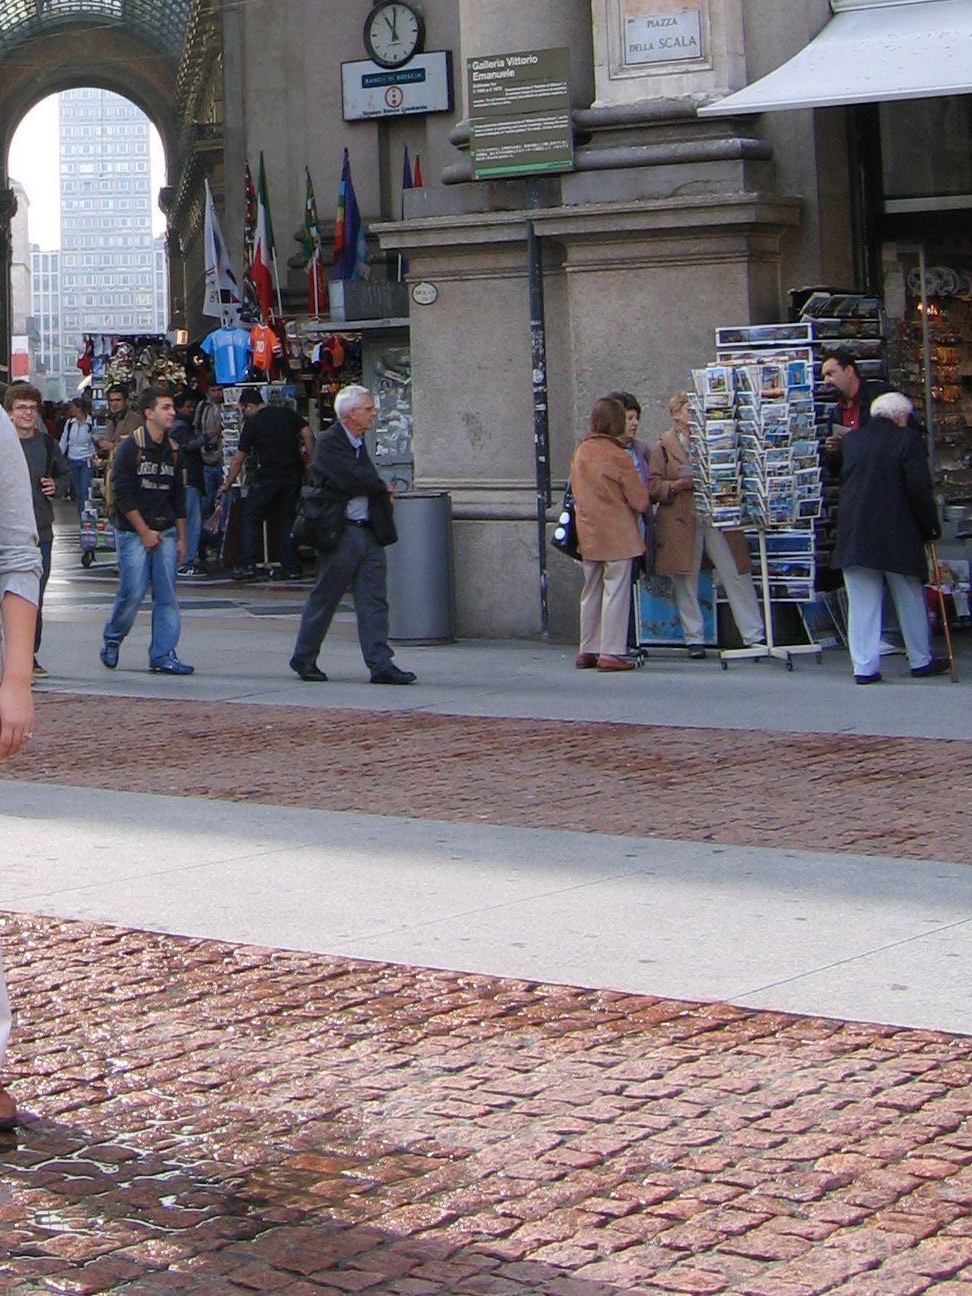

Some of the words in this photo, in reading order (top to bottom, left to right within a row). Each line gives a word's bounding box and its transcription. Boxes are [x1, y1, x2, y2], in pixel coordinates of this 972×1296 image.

[646, 17, 678, 28] PIAZZA
[629, 43, 654, 52] DELLA
[659, 35, 697, 49] SCALA
[472, 58, 505, 71] Galleria
[506, 54, 539, 67] Vittorio
[472, 69, 516, 82] Emanuele
